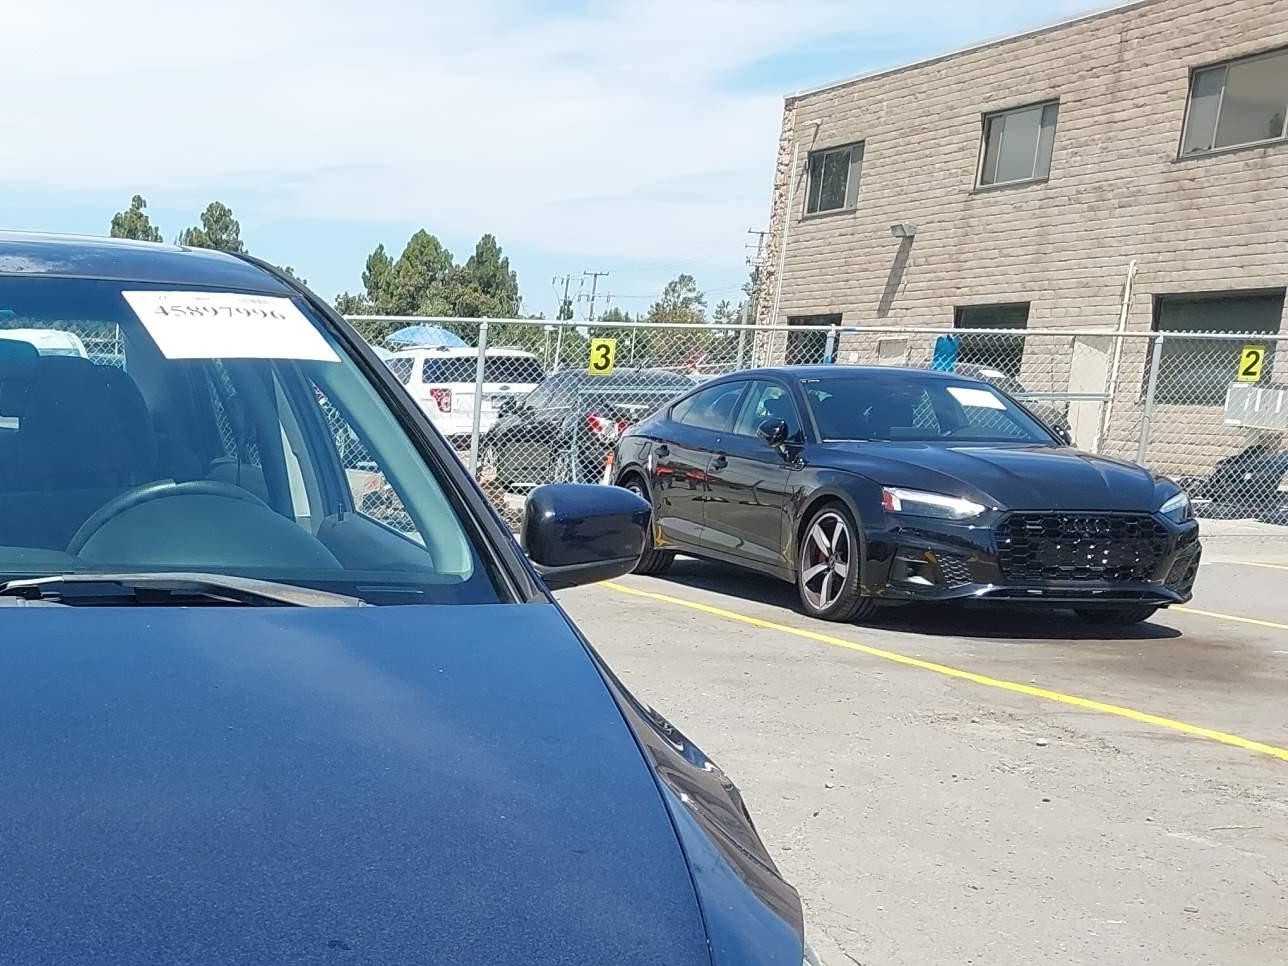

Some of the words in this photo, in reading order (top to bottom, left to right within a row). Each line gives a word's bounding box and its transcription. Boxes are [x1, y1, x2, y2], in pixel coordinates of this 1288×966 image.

[155, 304, 287, 321] 45897996
[593, 344, 611, 370] 3
[1242, 350, 1260, 376] 2
